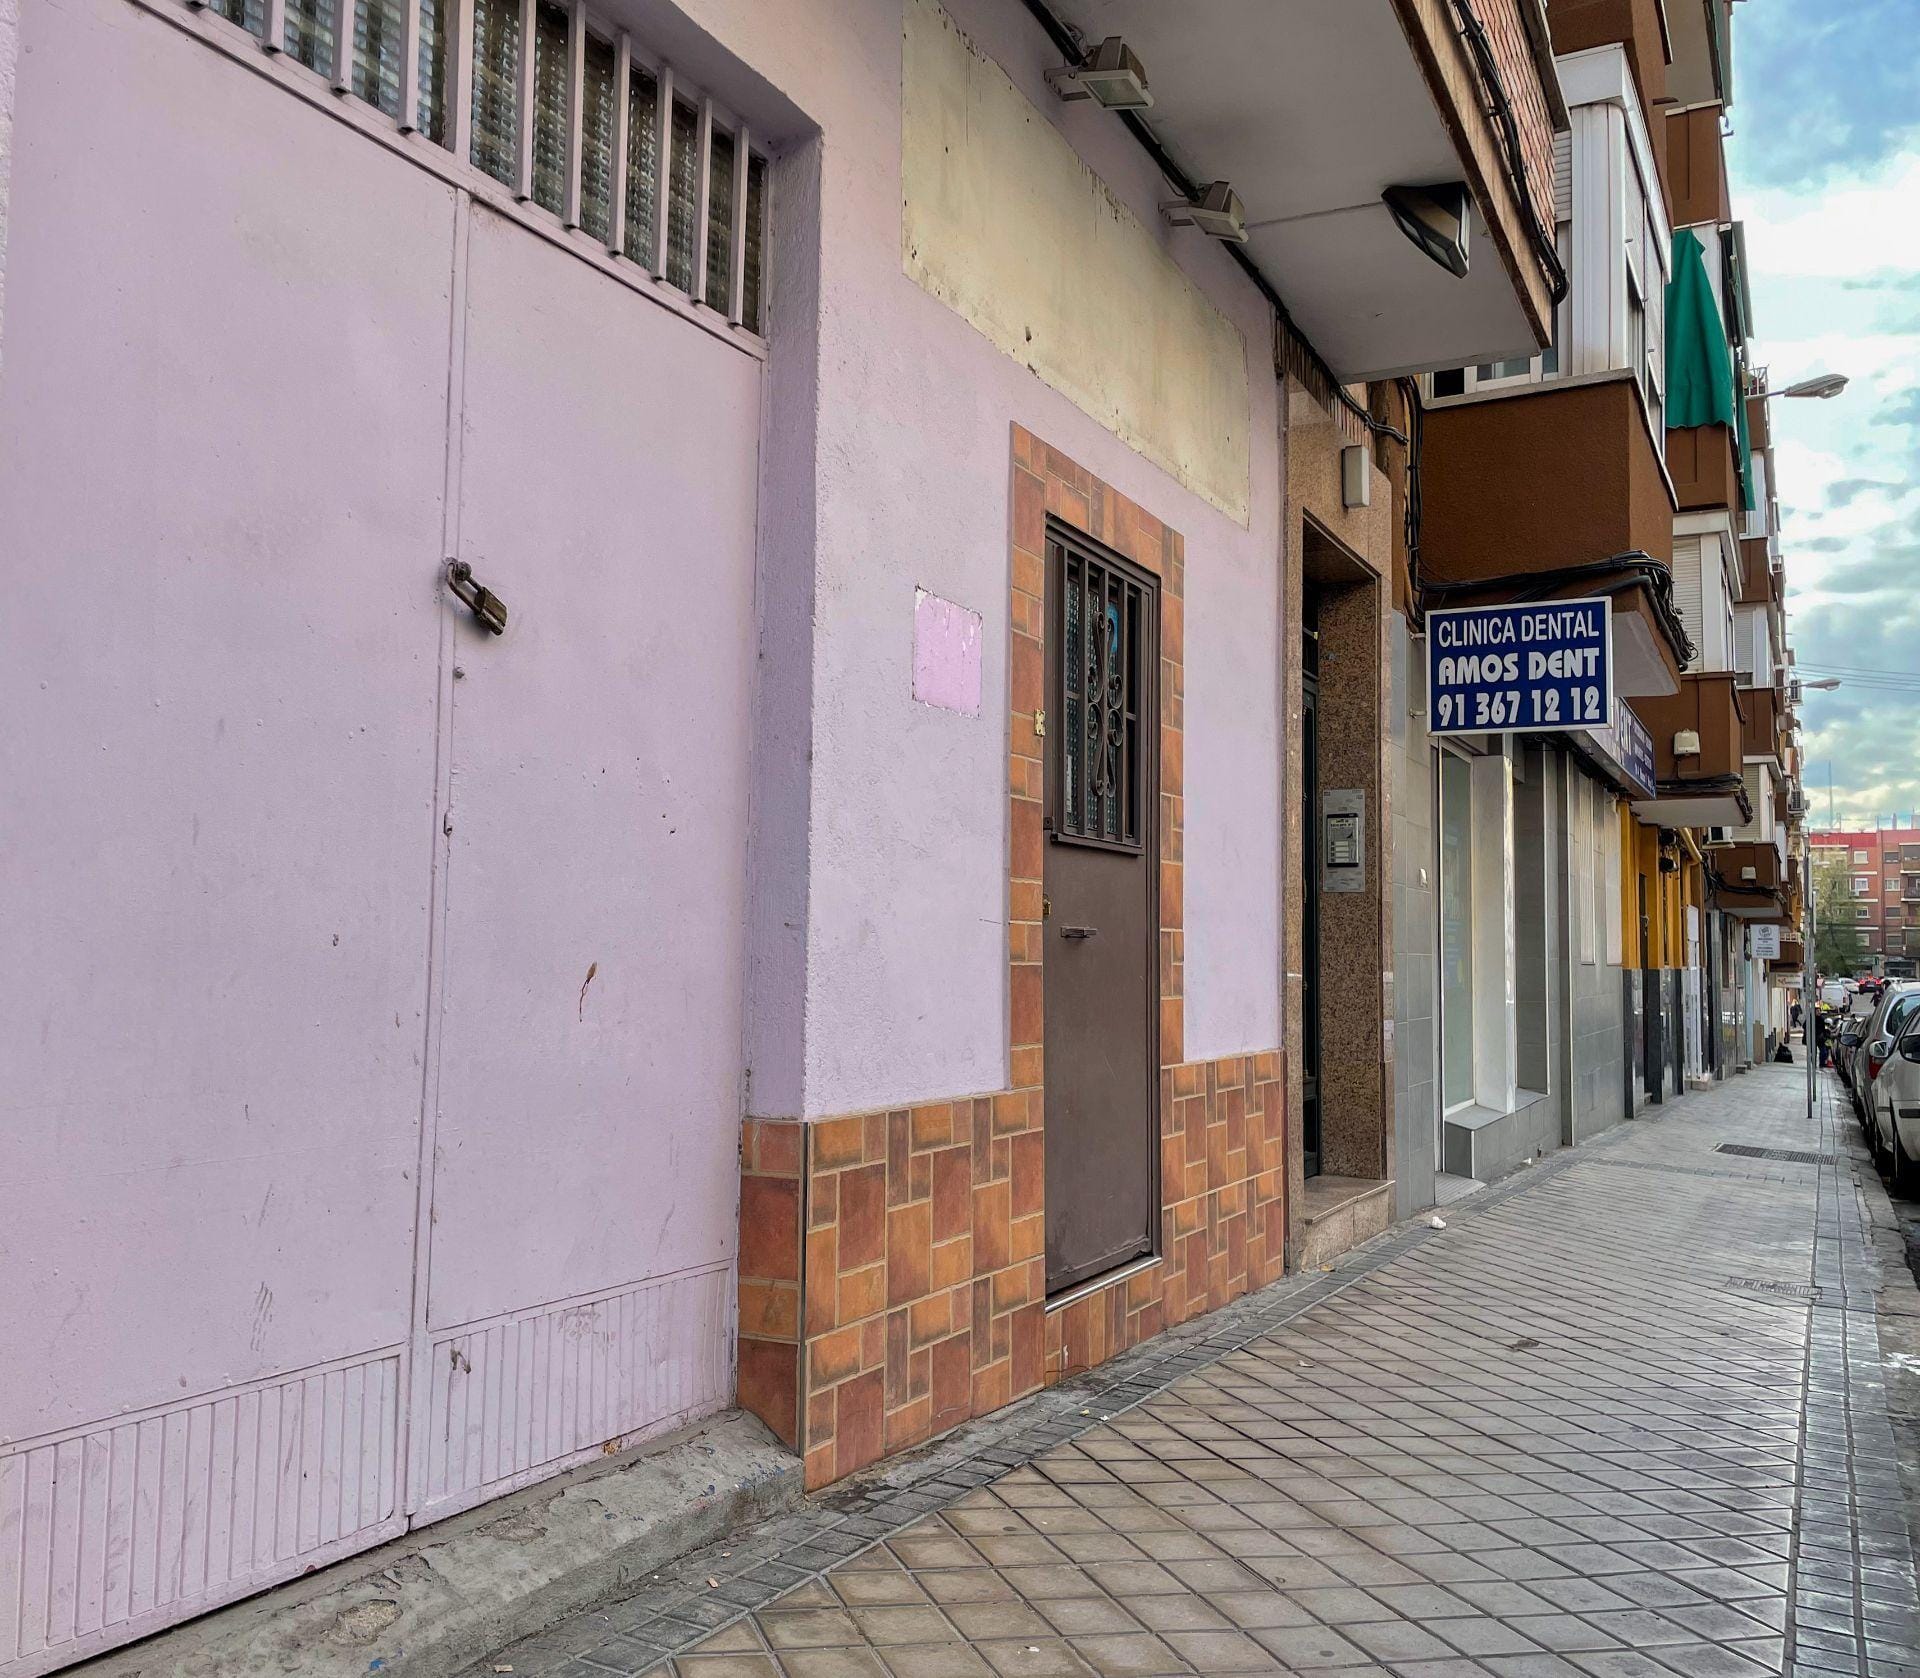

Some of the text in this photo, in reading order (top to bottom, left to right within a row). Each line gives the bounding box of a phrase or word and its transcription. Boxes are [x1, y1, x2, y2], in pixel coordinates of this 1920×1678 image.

[1438, 610, 1600, 648] CLINICA DENTAL
[1438, 647, 1600, 686] AMOS DENT
[1438, 685, 1600, 727] 91 367 12 12
